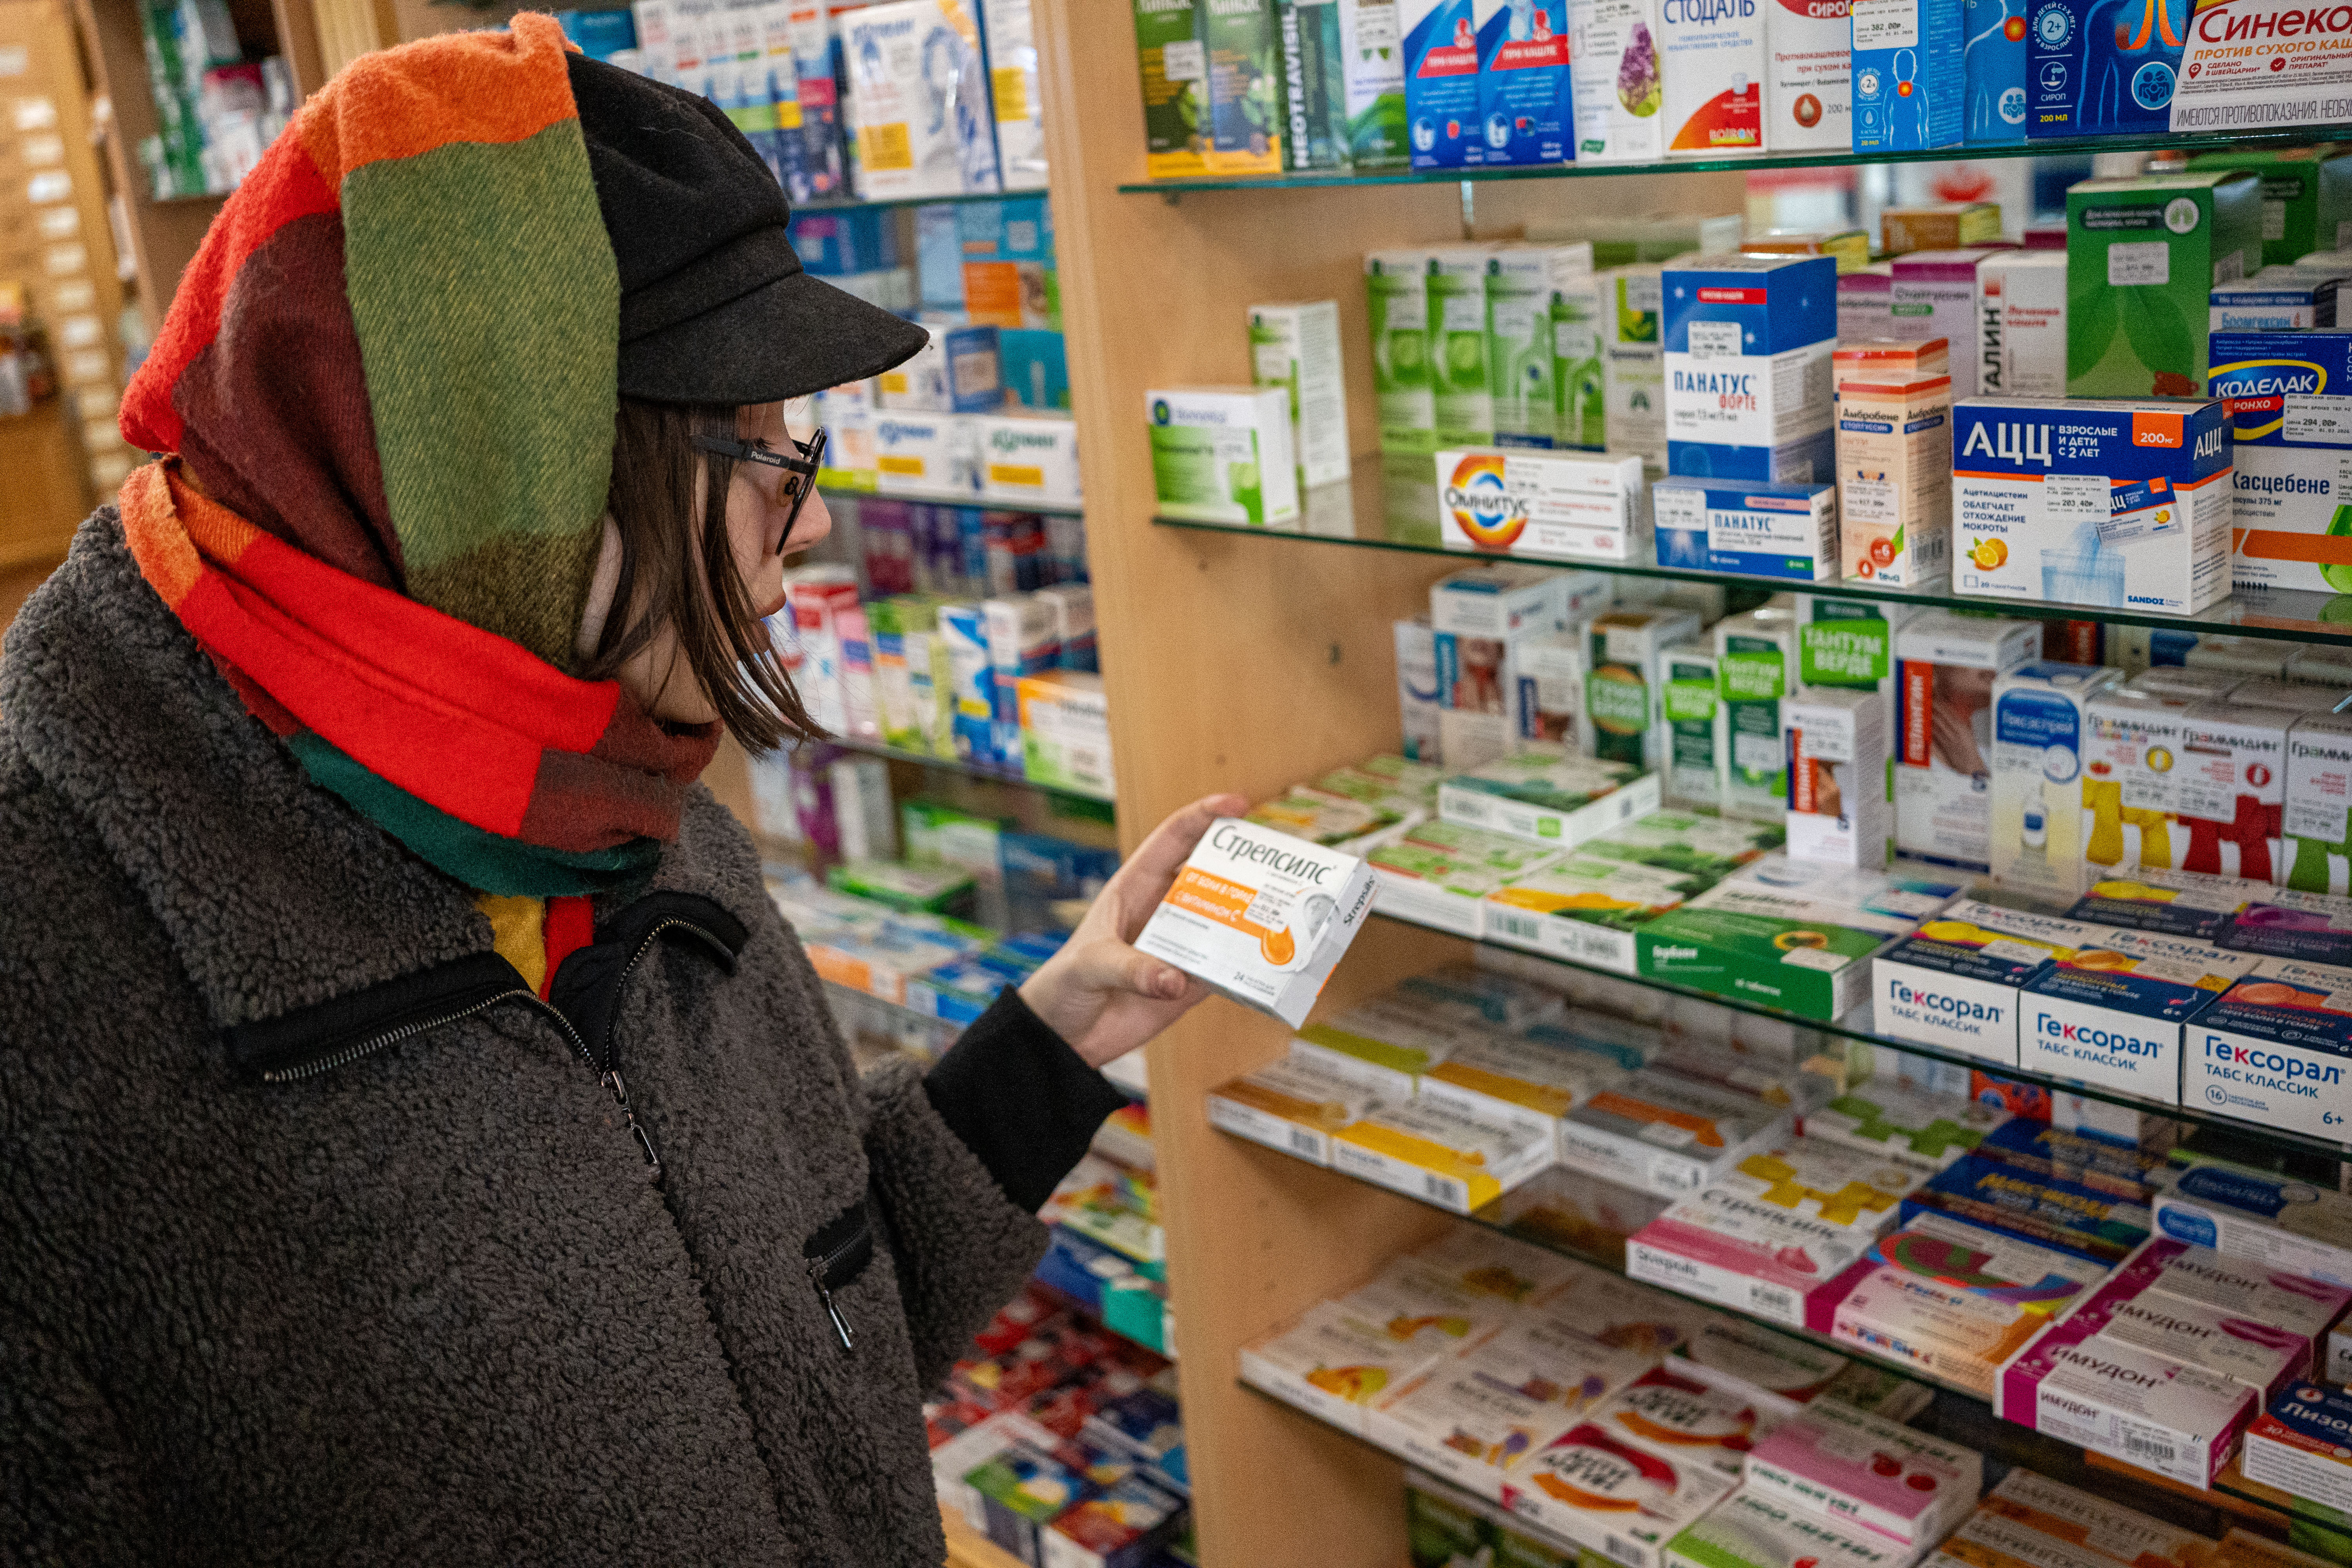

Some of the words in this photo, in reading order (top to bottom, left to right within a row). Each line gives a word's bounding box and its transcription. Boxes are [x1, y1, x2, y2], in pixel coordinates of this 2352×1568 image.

[1664, 0, 1755, 26] СТОДАЛЬ
[2036, 3, 2056, 20] ДЕТЕЙ
[2047, 21, 2062, 33] 2+
[2199, 5, 2352, 43] Синеко
[2038, 35, 2073, 51] ВЗРОСЛЫХ
[2194, 45, 2252, 60] ПРОТИВ
[2256, 41, 2316, 56] СУХОГО
[2207, 61, 2242, 69] СДЕЛАНО
[2291, 51, 2352, 62] ОРИГИНАЛЬНЫЙ
[2041, 93, 2066, 102] СИРОП
[2040, 114, 2054, 123] 200
[2177, 107, 2220, 126] ИМЕЮТСЯ
[2222, 100, 2318, 123] ПРОТИВОПОКАЗАНИЯ.
[1674, 370, 1750, 394] ПАНАТУС
[2216, 374, 2314, 398] КОДЕЛАК
[2234, 399, 2271, 410] РОНХО
[2059, 425, 2117, 436] ВЗРОСЛЫЕ
[2059, 436, 2065, 445] И
[2069, 437, 2098, 447] ДЕТИ
[1962, 421, 2052, 466] АЦЦ
[2069, 448, 2076, 458] 2
[2079, 448, 2100, 457] ЛЕТ
[2194, 427, 2221, 460] АЦЦ
[1963, 488, 2028, 499] Ацетилцистеин
[2259, 497, 2272, 505] 375
[1963, 501, 2014, 511] ОБЛЕГЧАЕТ
[1963, 511, 2026, 523] ОТХОЖДЕНИЕ
[1714, 513, 1771, 532] ПАНАТУС
[1963, 522, 2008, 533] МОКРОТЫ
[2128, 595, 2164, 605] SANDOZ
[1805, 628, 1882, 655] ТАНТУМ
[1212, 825, 1332, 885] Стрепсилс
[1186, 872, 1200, 882] ОТ
[1198, 876, 1221, 891] БОЛИ
[1219, 884, 1228, 895] В
[1228, 886, 1254, 904] ГОРЛЕ
[1182, 892, 1231, 918] ВИТАМИНОМ
[1230, 909, 1241, 922] С
[1343, 875, 1375, 926] Strepsils
[2111, 931, 2238, 963] Гексорал
[1234, 971, 1245, 981] 24
[1890, 980, 2000, 1023] Гексорал
[1890, 1005, 1920, 1021] ТАБС
[1924, 1011, 1981, 1035] КЛАССИК
[2037, 1012, 2158, 1059] Гексорал
[2037, 1039, 2070, 1057] ТАБС
[2074, 1047, 2137, 1072] КЛАССИК
[2205, 1035, 2339, 1085] Гексорал
[2204, 1063, 2242, 1083] ТАБС
[2245, 1072, 2319, 1099] КЛАССИК
[2210, 1088, 2221, 1101] 16
[2323, 1112, 2344, 1125] 6+
[2158, 1256, 2259, 1291] ИМУДОН
[2111, 1299, 2213, 1339] ИМУДОН
[2051, 1345, 2161, 1389] ИМУДОН
[2040, 1392, 2097, 1419] ИМУДОН
[2280, 1402, 2352, 1435] Лизо
